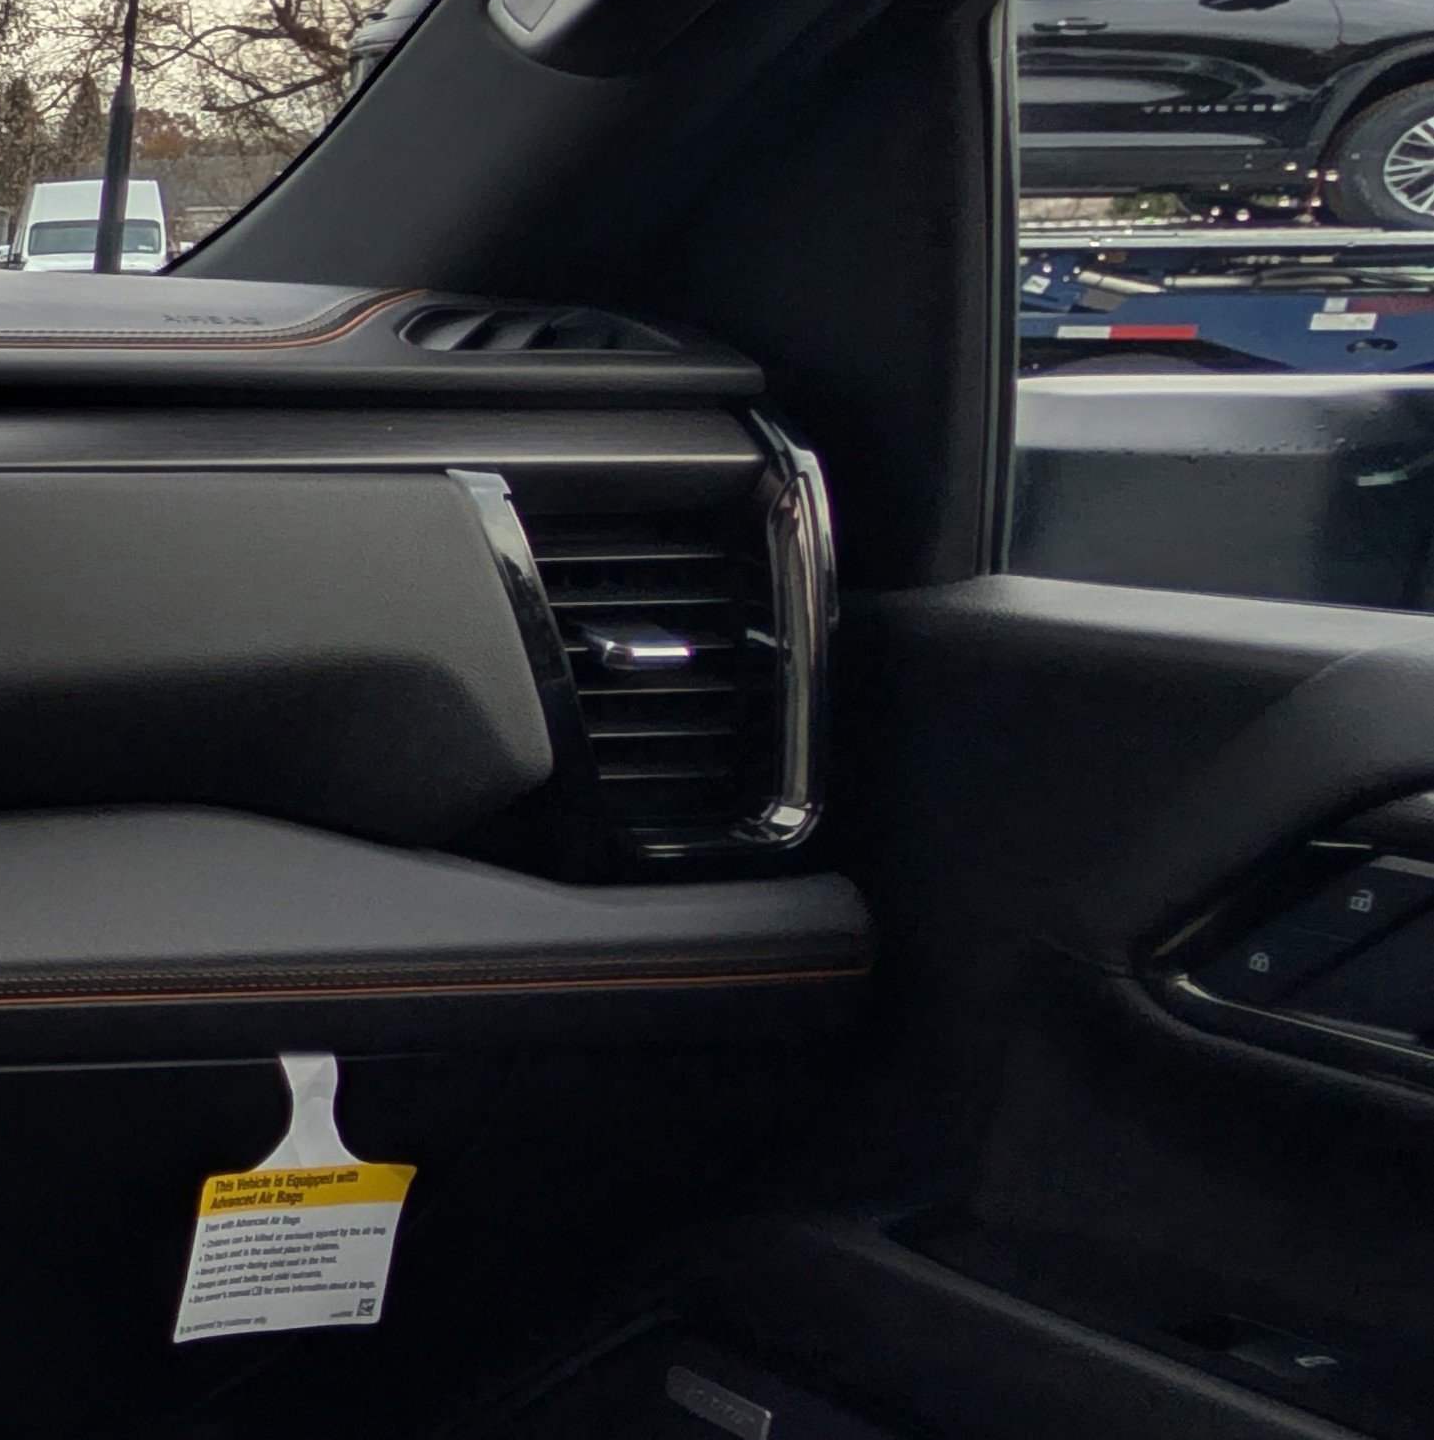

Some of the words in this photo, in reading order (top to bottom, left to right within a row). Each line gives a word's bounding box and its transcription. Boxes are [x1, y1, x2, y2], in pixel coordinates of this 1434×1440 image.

[215, 1179, 234, 1194] This
[236, 1176, 271, 1191] Vehicle
[273, 1174, 283, 1187] is
[285, 1172, 334, 1190] Equipped
[337, 1170, 359, 1183] with
[211, 1192, 256, 1209] Advanced
[258, 1191, 274, 1204] Air
[276, 1190, 304, 1206] Bags
